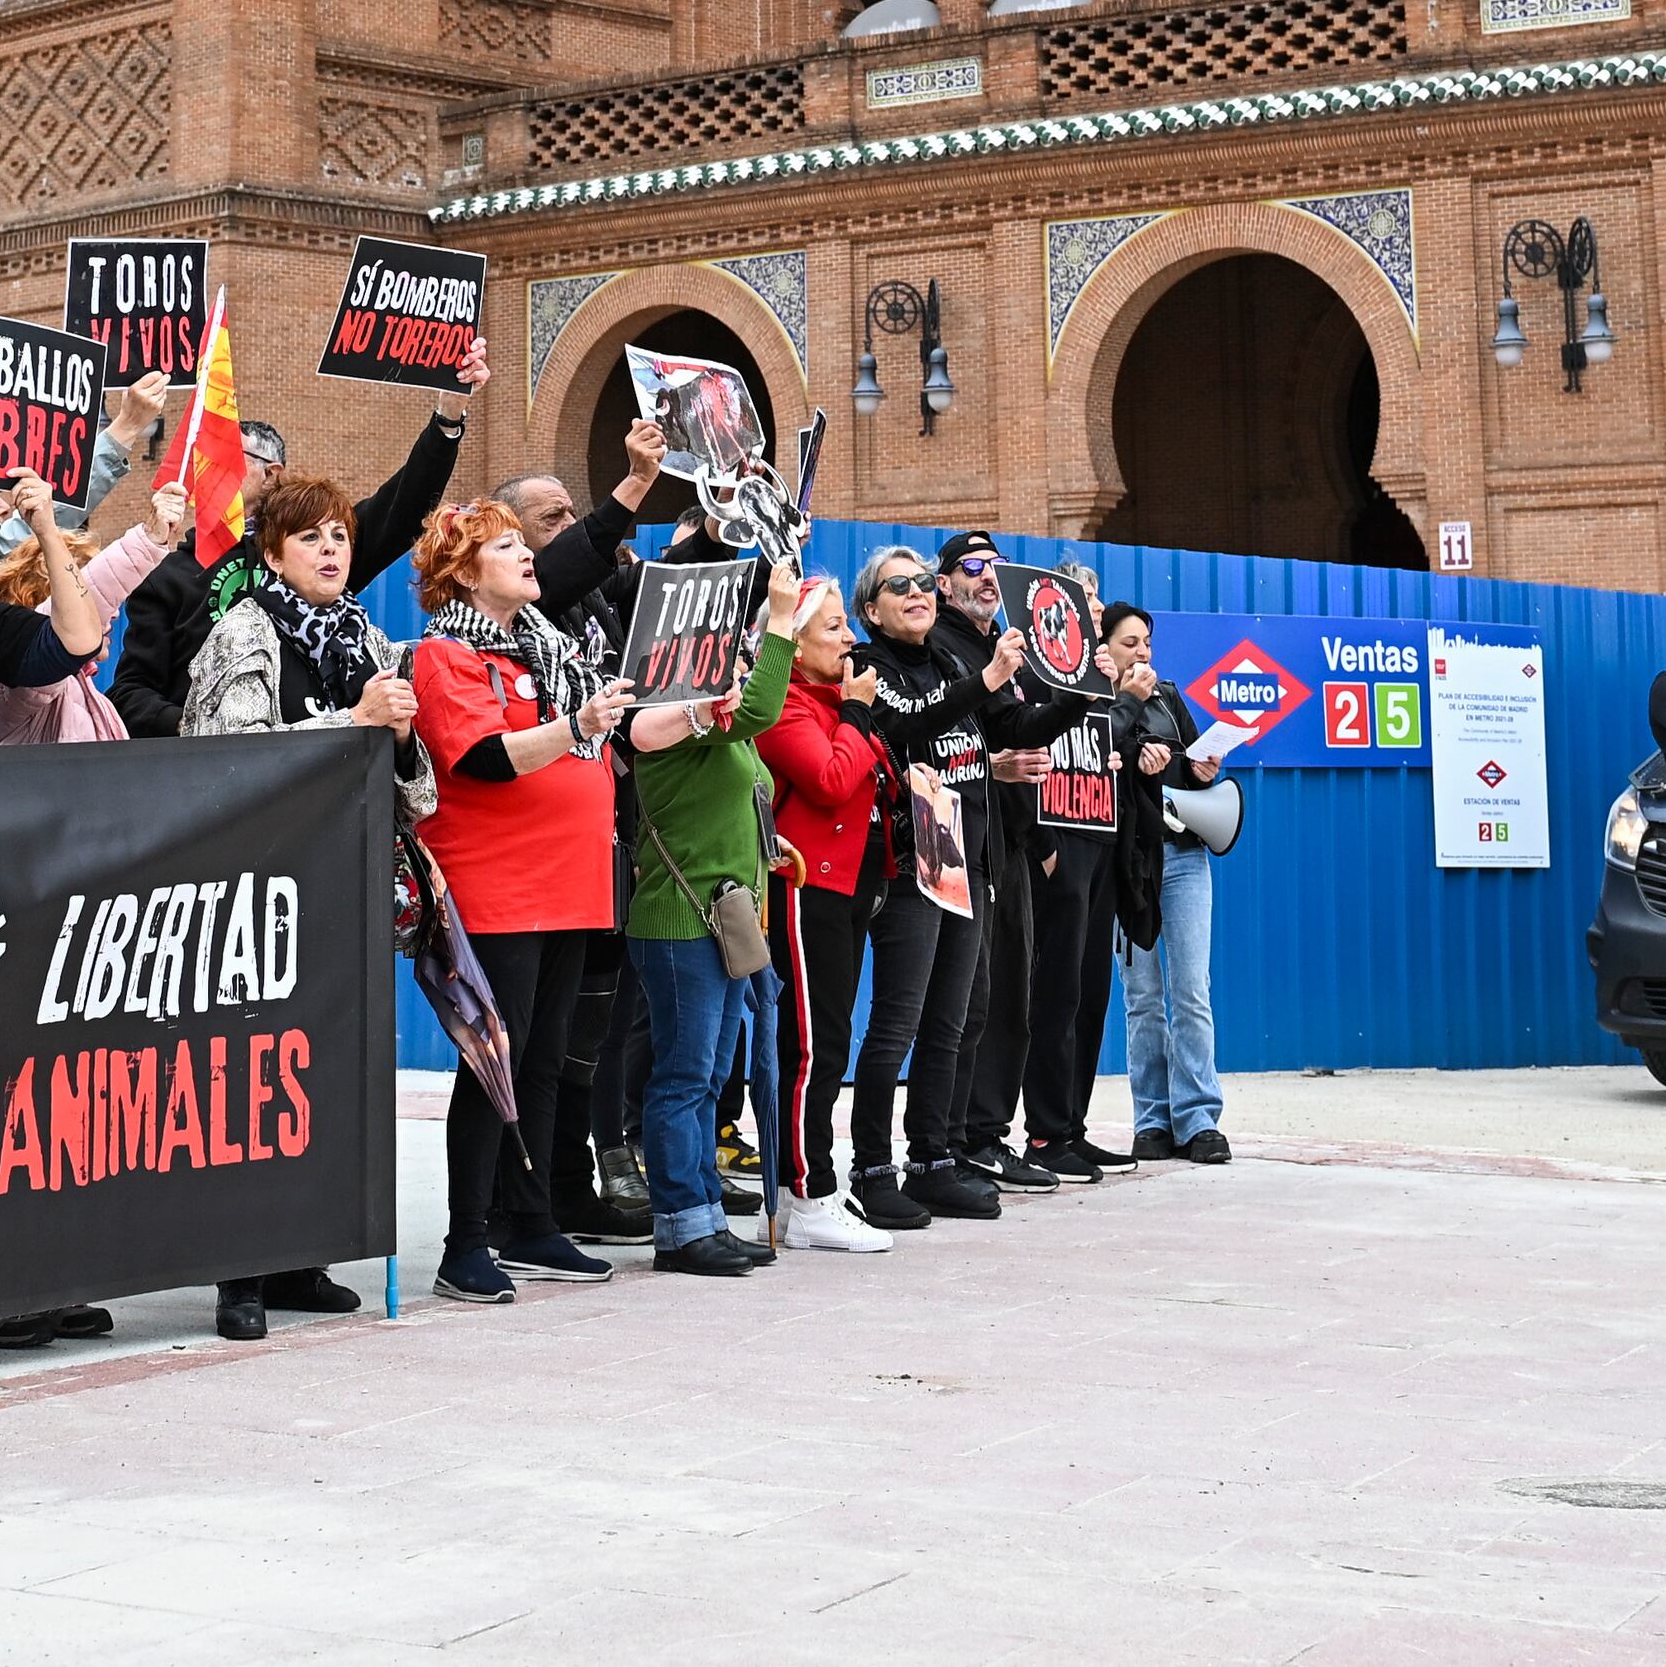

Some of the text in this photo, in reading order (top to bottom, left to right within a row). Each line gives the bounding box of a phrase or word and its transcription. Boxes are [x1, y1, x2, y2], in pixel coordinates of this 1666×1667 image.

[88, 253, 194, 315] TOROS
[350, 259, 477, 323] SÍ BOMBEROS
[333, 309, 476, 370] NO TOREROS
[1443, 535, 1469, 565] 11
[655, 574, 743, 637] TOROS
[644, 633, 733, 691] VIVOS
[1321, 636, 1419, 673] Ventas
[1220, 679, 1276, 704] Metro
[1334, 690, 1411, 739] 2 5
[1463, 694, 1504, 702] ACCESIBILIDAD
[1466, 704, 1499, 712] COMUNIDAD
[1508, 705, 1528, 713] MADRID
[1475, 714, 1494, 722] METRO
[1070, 716, 1102, 774] MÁS
[1042, 771, 1113, 822] VIOLENCIA
[1492, 798, 1499, 806] DE
[1500, 798, 1521, 806] VENTAS
[1481, 824, 1506, 841] 2 5
[36, 872, 299, 1026] LIBERTAD
